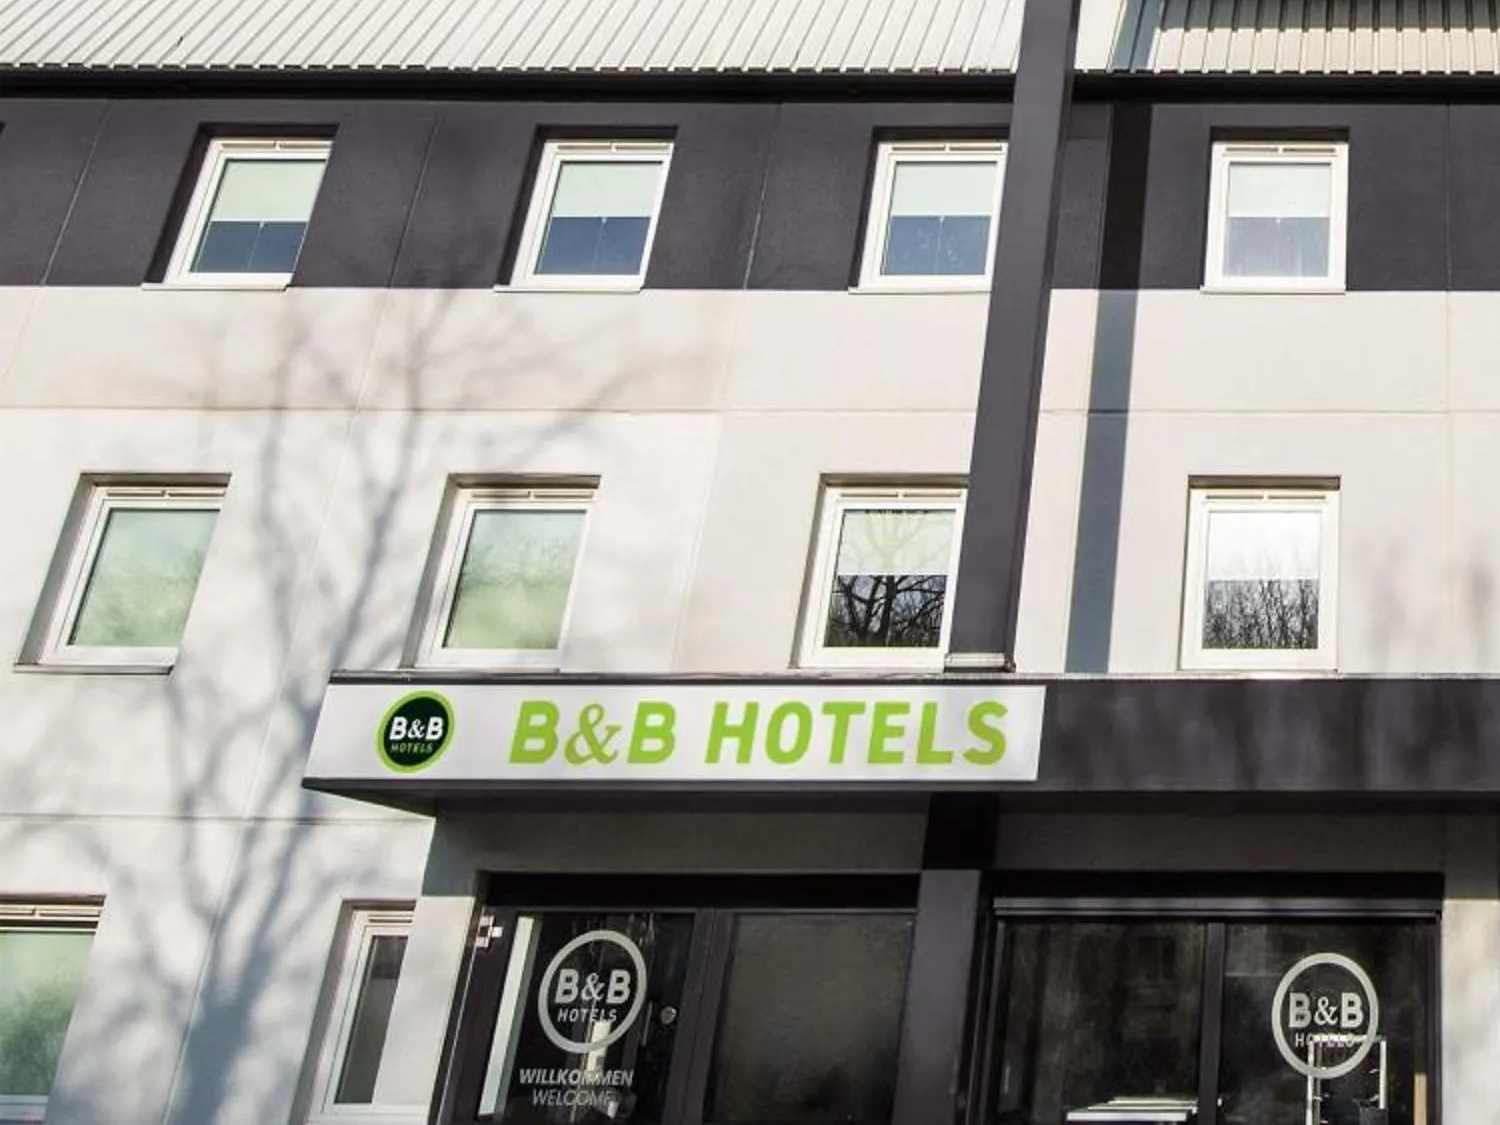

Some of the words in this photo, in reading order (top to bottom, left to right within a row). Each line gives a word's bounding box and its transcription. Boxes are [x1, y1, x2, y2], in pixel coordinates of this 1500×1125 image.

[389, 716, 444, 740] B&B
[509, 701, 676, 764] B&B
[704, 701, 1009, 765] HOTELS
[391, 742, 433, 754] HOTELS
[555, 968, 631, 1004] B&B
[1288, 992, 1364, 1028] B&B
